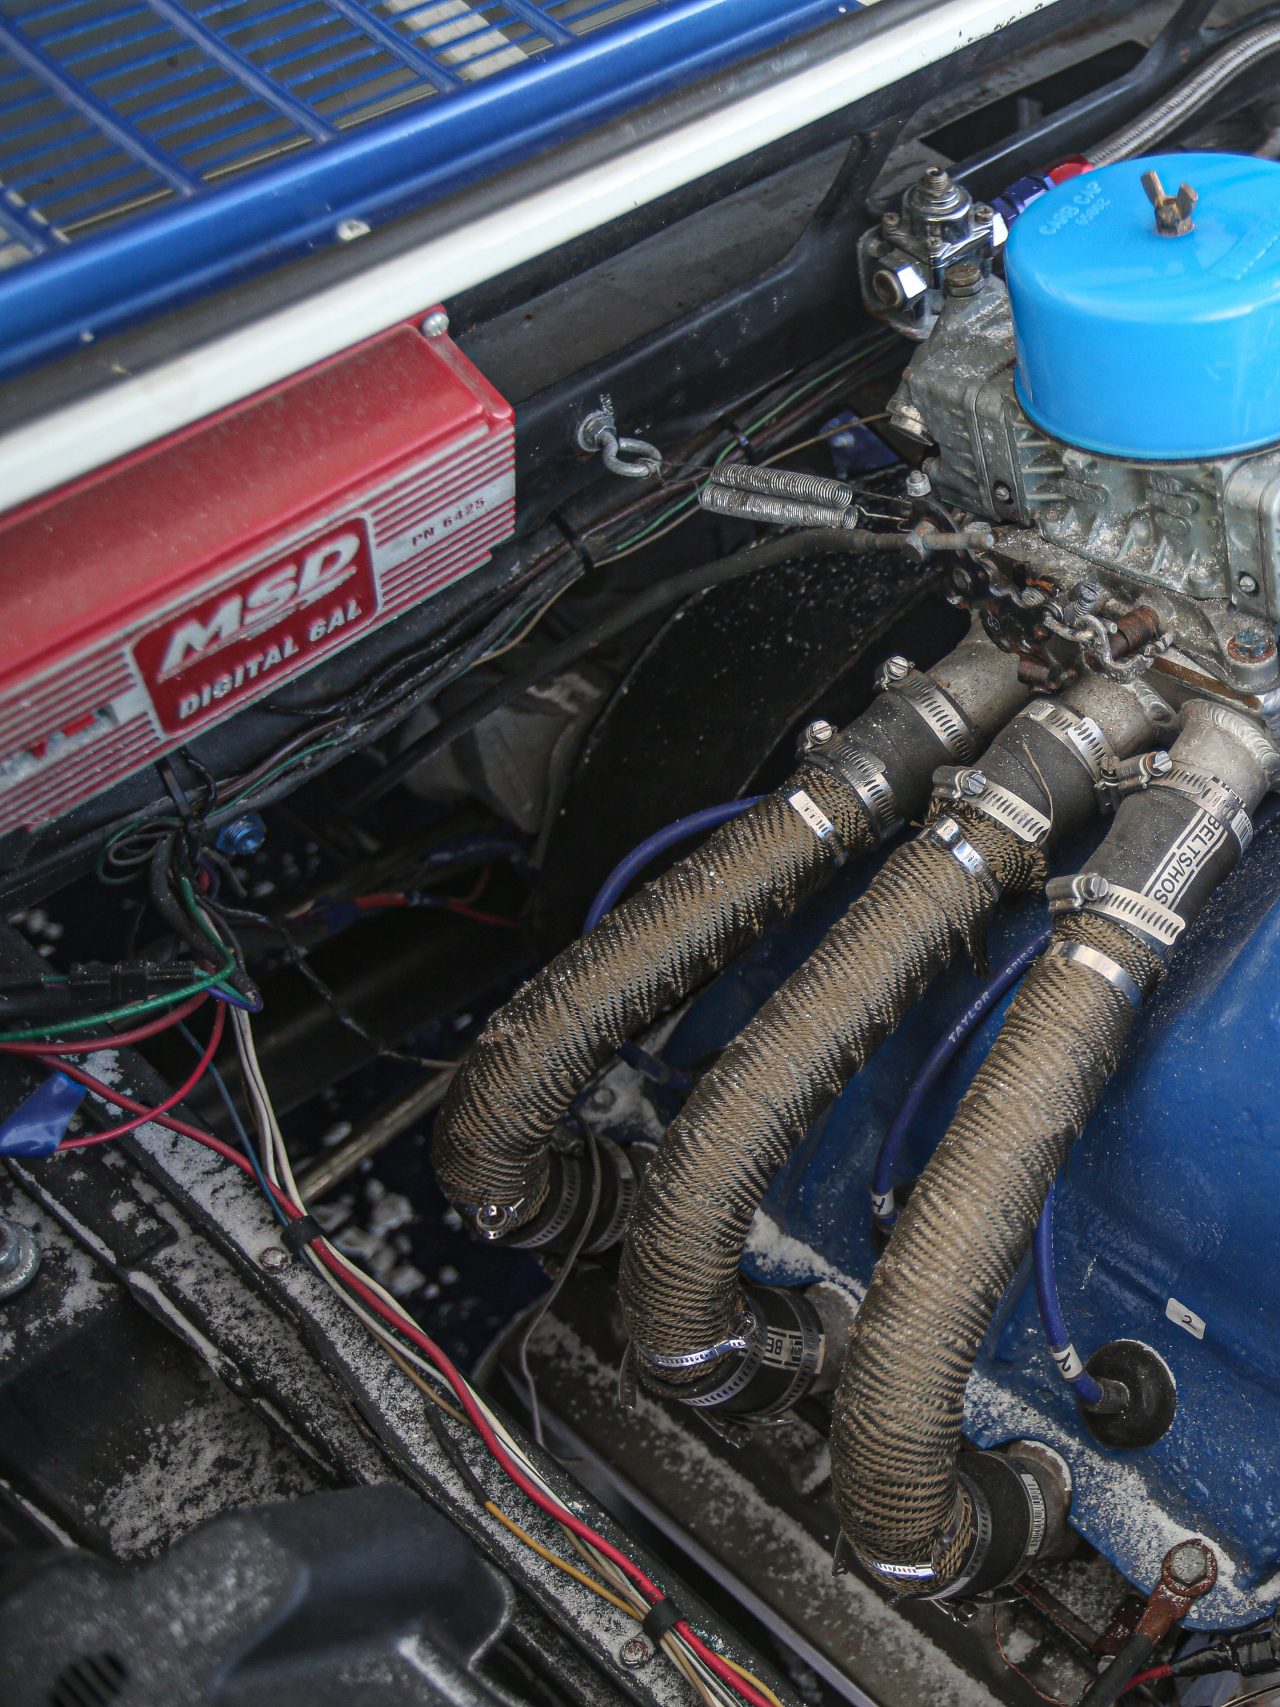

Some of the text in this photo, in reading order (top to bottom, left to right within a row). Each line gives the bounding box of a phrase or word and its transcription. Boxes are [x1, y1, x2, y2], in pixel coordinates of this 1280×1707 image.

[1073, 181, 1102, 204] CAP
[411, 498, 486, 547] PN 6425
[157, 532, 361, 675] MSD
[179, 599, 364, 720] DIGITAL 6AL
[1153, 815, 1221, 906] BELTS/HOS
[948, 990, 990, 1043] TAYLOR
[1005, 946, 1035, 975] SPIRO
